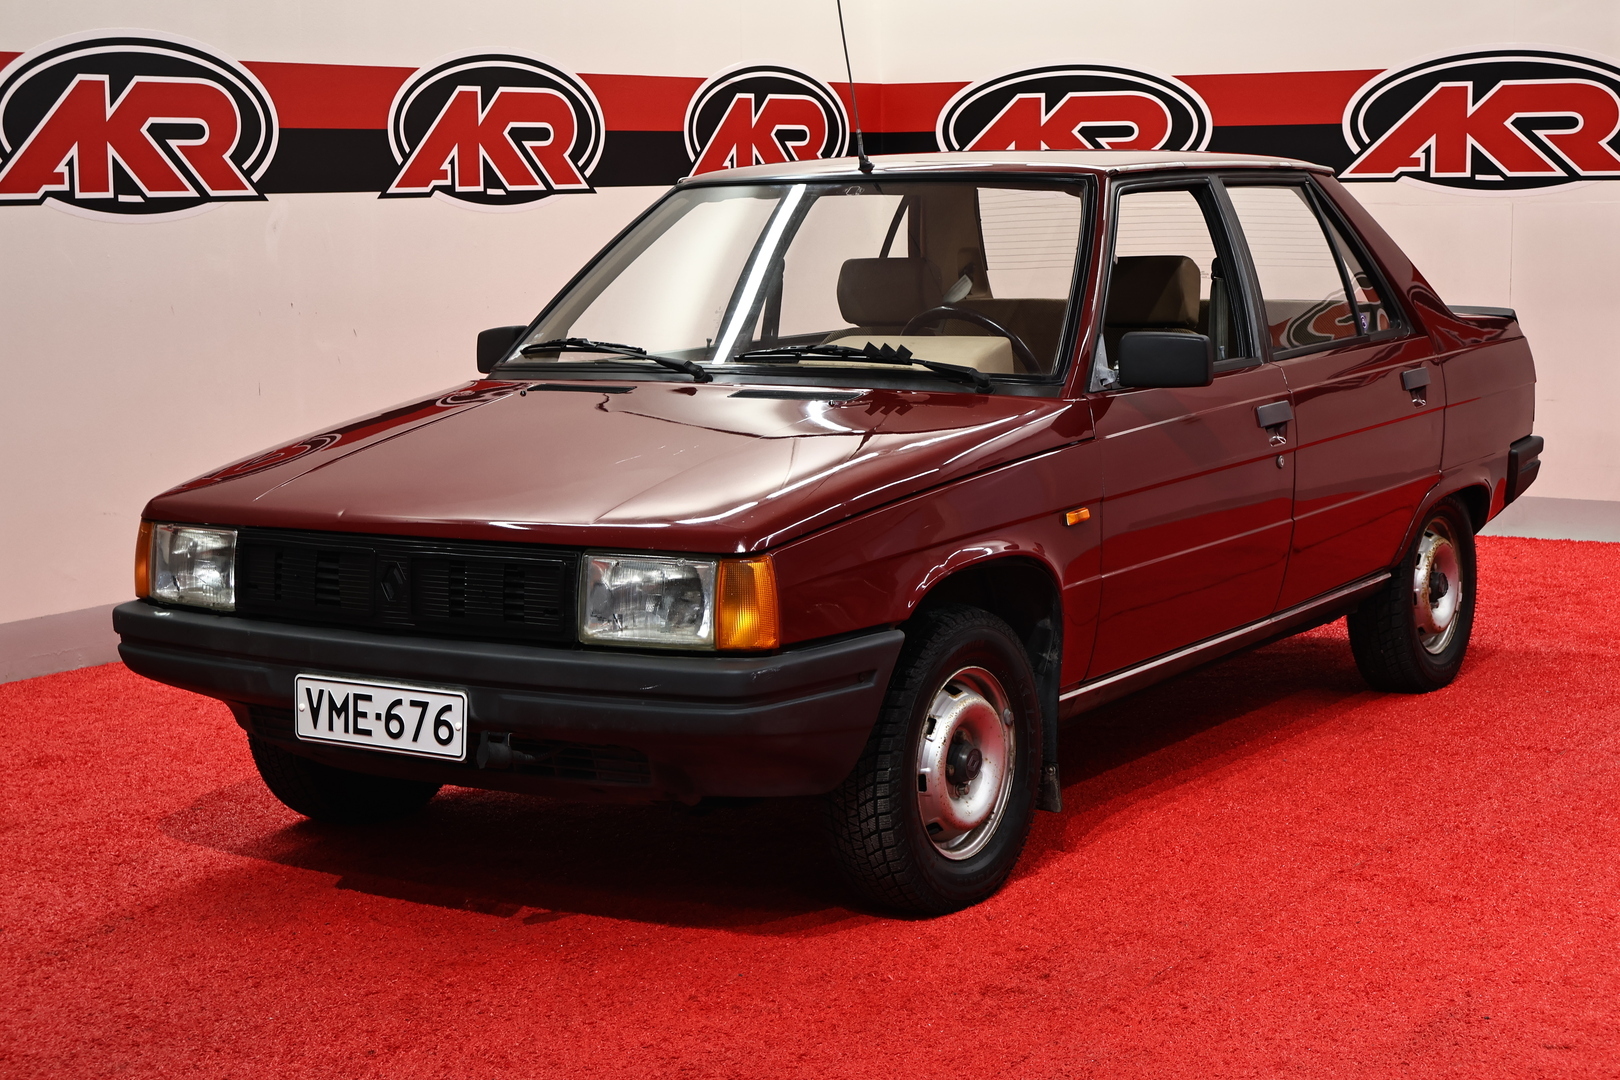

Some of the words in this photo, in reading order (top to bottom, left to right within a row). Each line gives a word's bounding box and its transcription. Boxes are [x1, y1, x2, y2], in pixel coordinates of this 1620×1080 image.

[0, 74, 260, 200] AKR
[386, 86, 591, 194] AKR
[690, 93, 824, 176] AKR
[1337, 77, 1620, 178] AKR
[305, 687, 454, 746] VME-676
